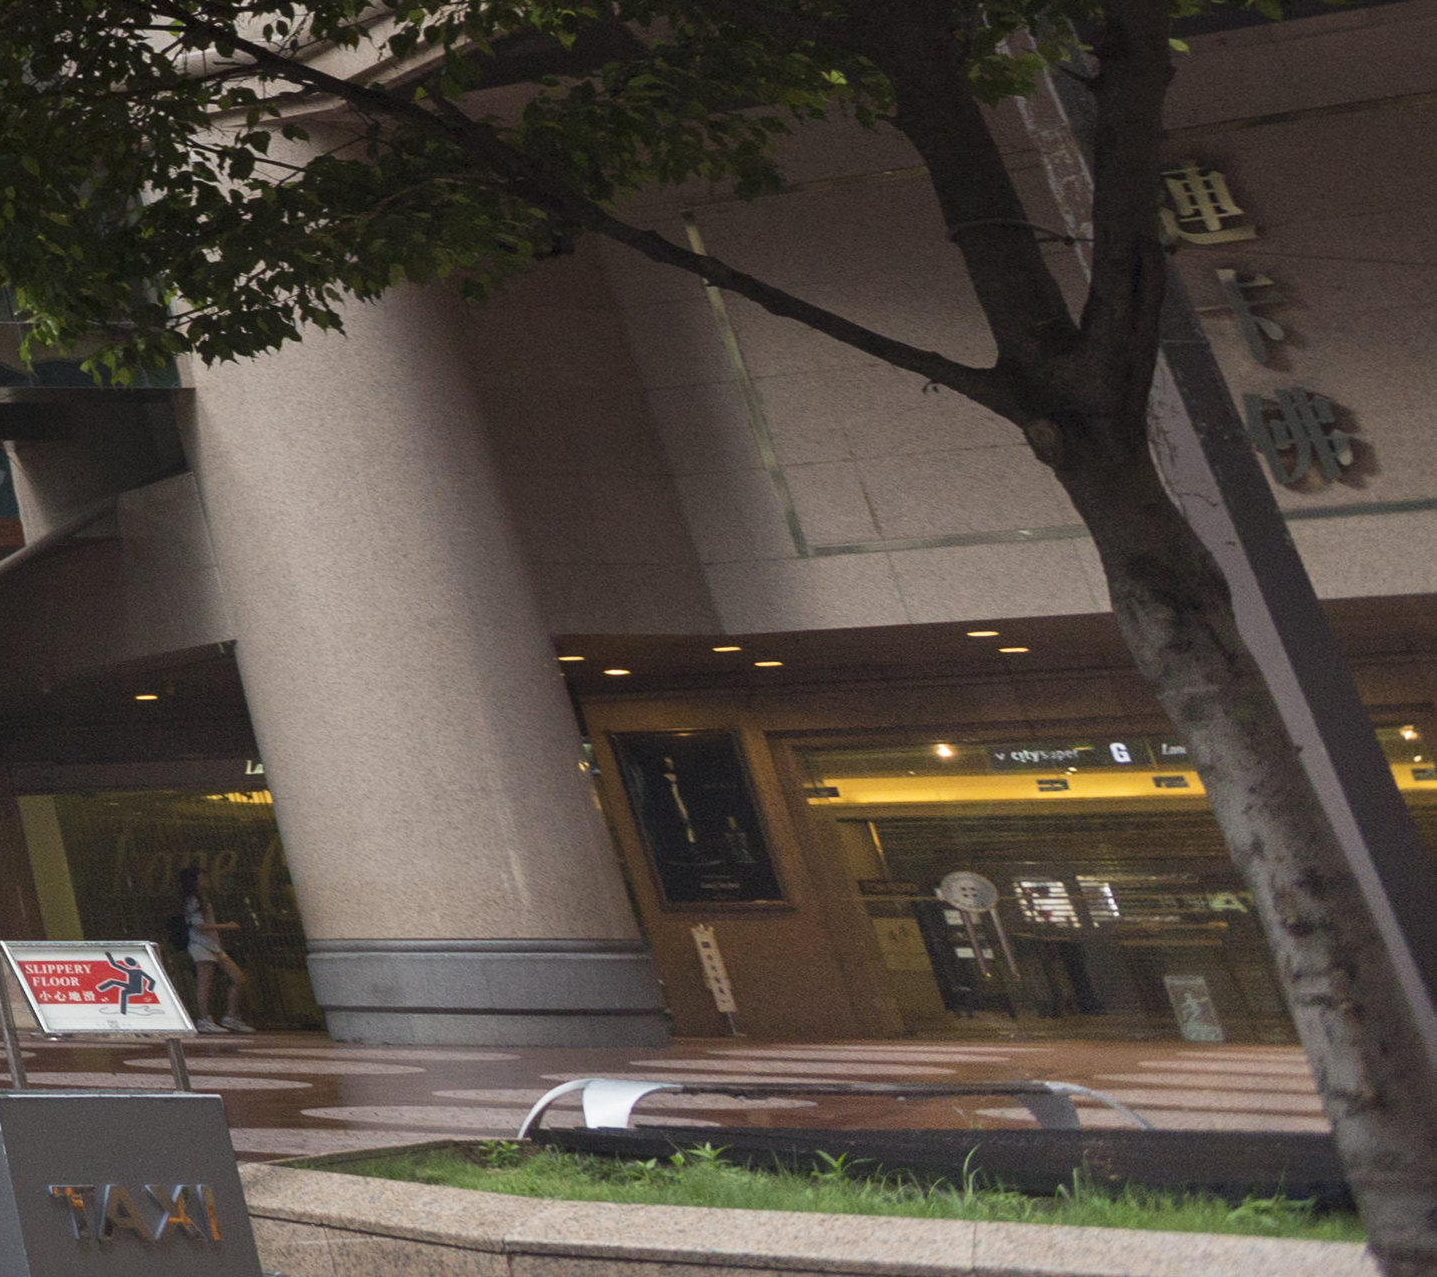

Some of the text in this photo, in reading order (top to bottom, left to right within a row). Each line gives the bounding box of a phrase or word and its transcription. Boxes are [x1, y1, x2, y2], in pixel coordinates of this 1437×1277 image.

[1158, 162, 1356, 486] 連卡佛
[1109, 742, 1133, 764] G
[24, 963, 93, 976] SLIPPERY
[31, 976, 81, 987] FLOOR
[39, 990, 97, 1003] 小心地滑
[47, 1182, 225, 1242] TAXI
